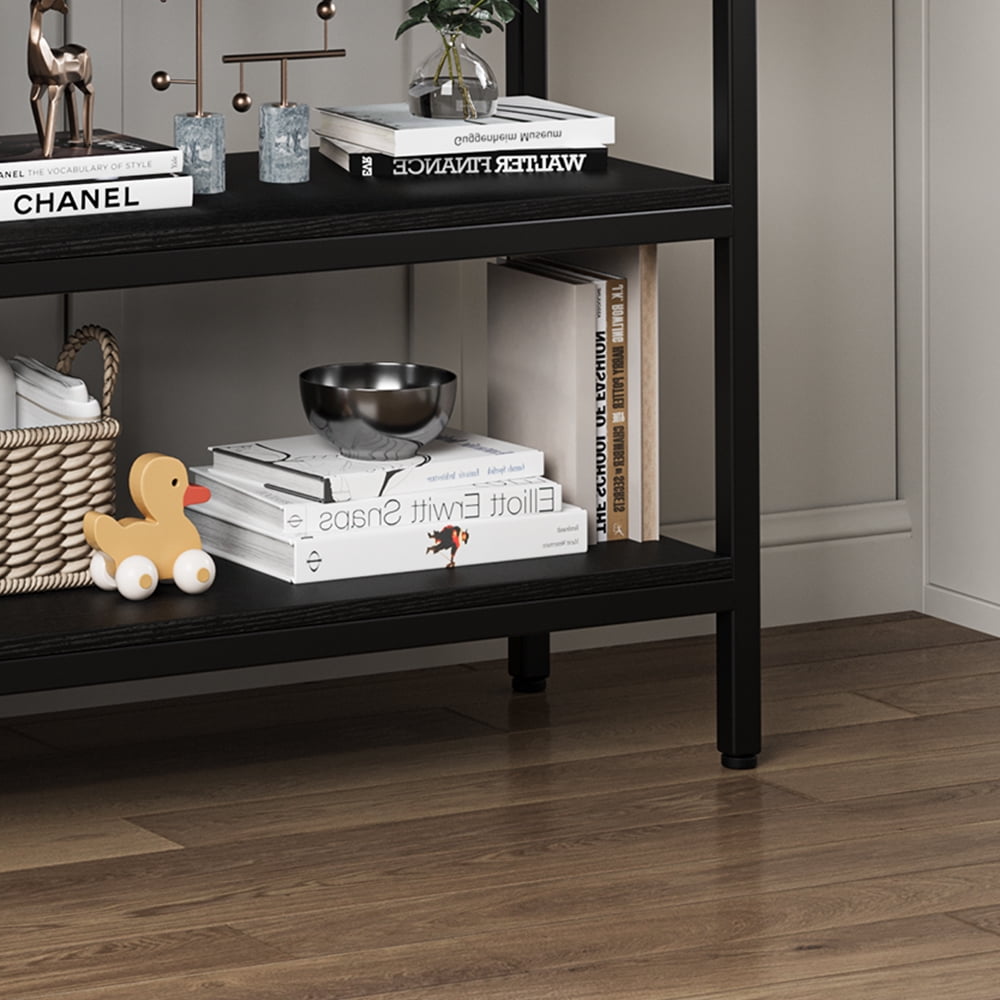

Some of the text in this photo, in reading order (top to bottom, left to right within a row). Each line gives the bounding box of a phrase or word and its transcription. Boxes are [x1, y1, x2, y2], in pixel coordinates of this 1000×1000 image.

[28, 169, 44, 177] THE
[47, 163, 108, 176] VOCABULARY
[111, 162, 122, 170] OF
[125, 160, 152, 169] STYLE
[14, 186, 140, 215] CHANEL
